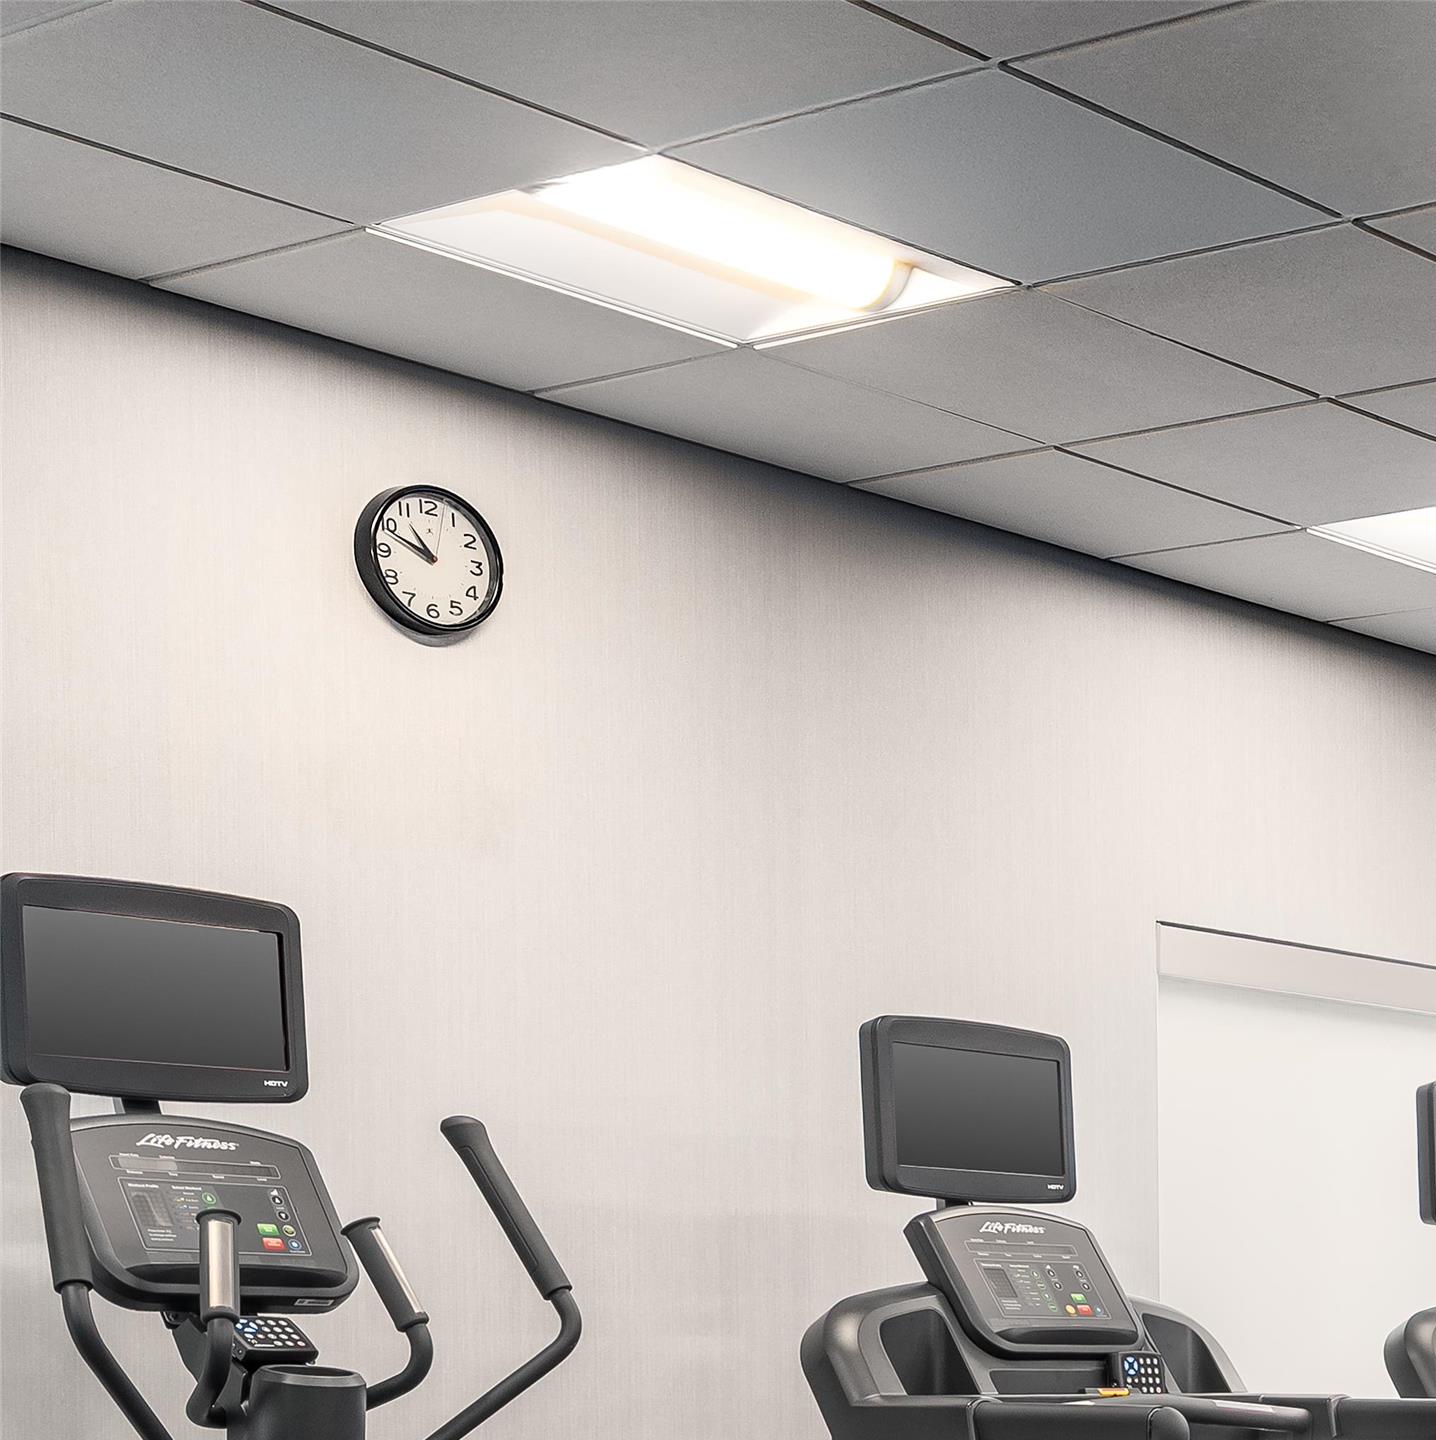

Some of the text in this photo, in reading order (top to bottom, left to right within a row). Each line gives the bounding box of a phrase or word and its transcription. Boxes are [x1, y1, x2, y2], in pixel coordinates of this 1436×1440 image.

[398, 501, 410, 518] 11
[418, 499, 438, 517] 12
[463, 533, 477, 550] 2
[377, 542, 391, 558] 9
[469, 559, 483, 577] 3
[384, 569, 399, 585] 8
[402, 591, 416, 607] 7
[465, 585, 479, 601] 4
[426, 603, 440, 618] 6
[449, 600, 463, 616] 5
